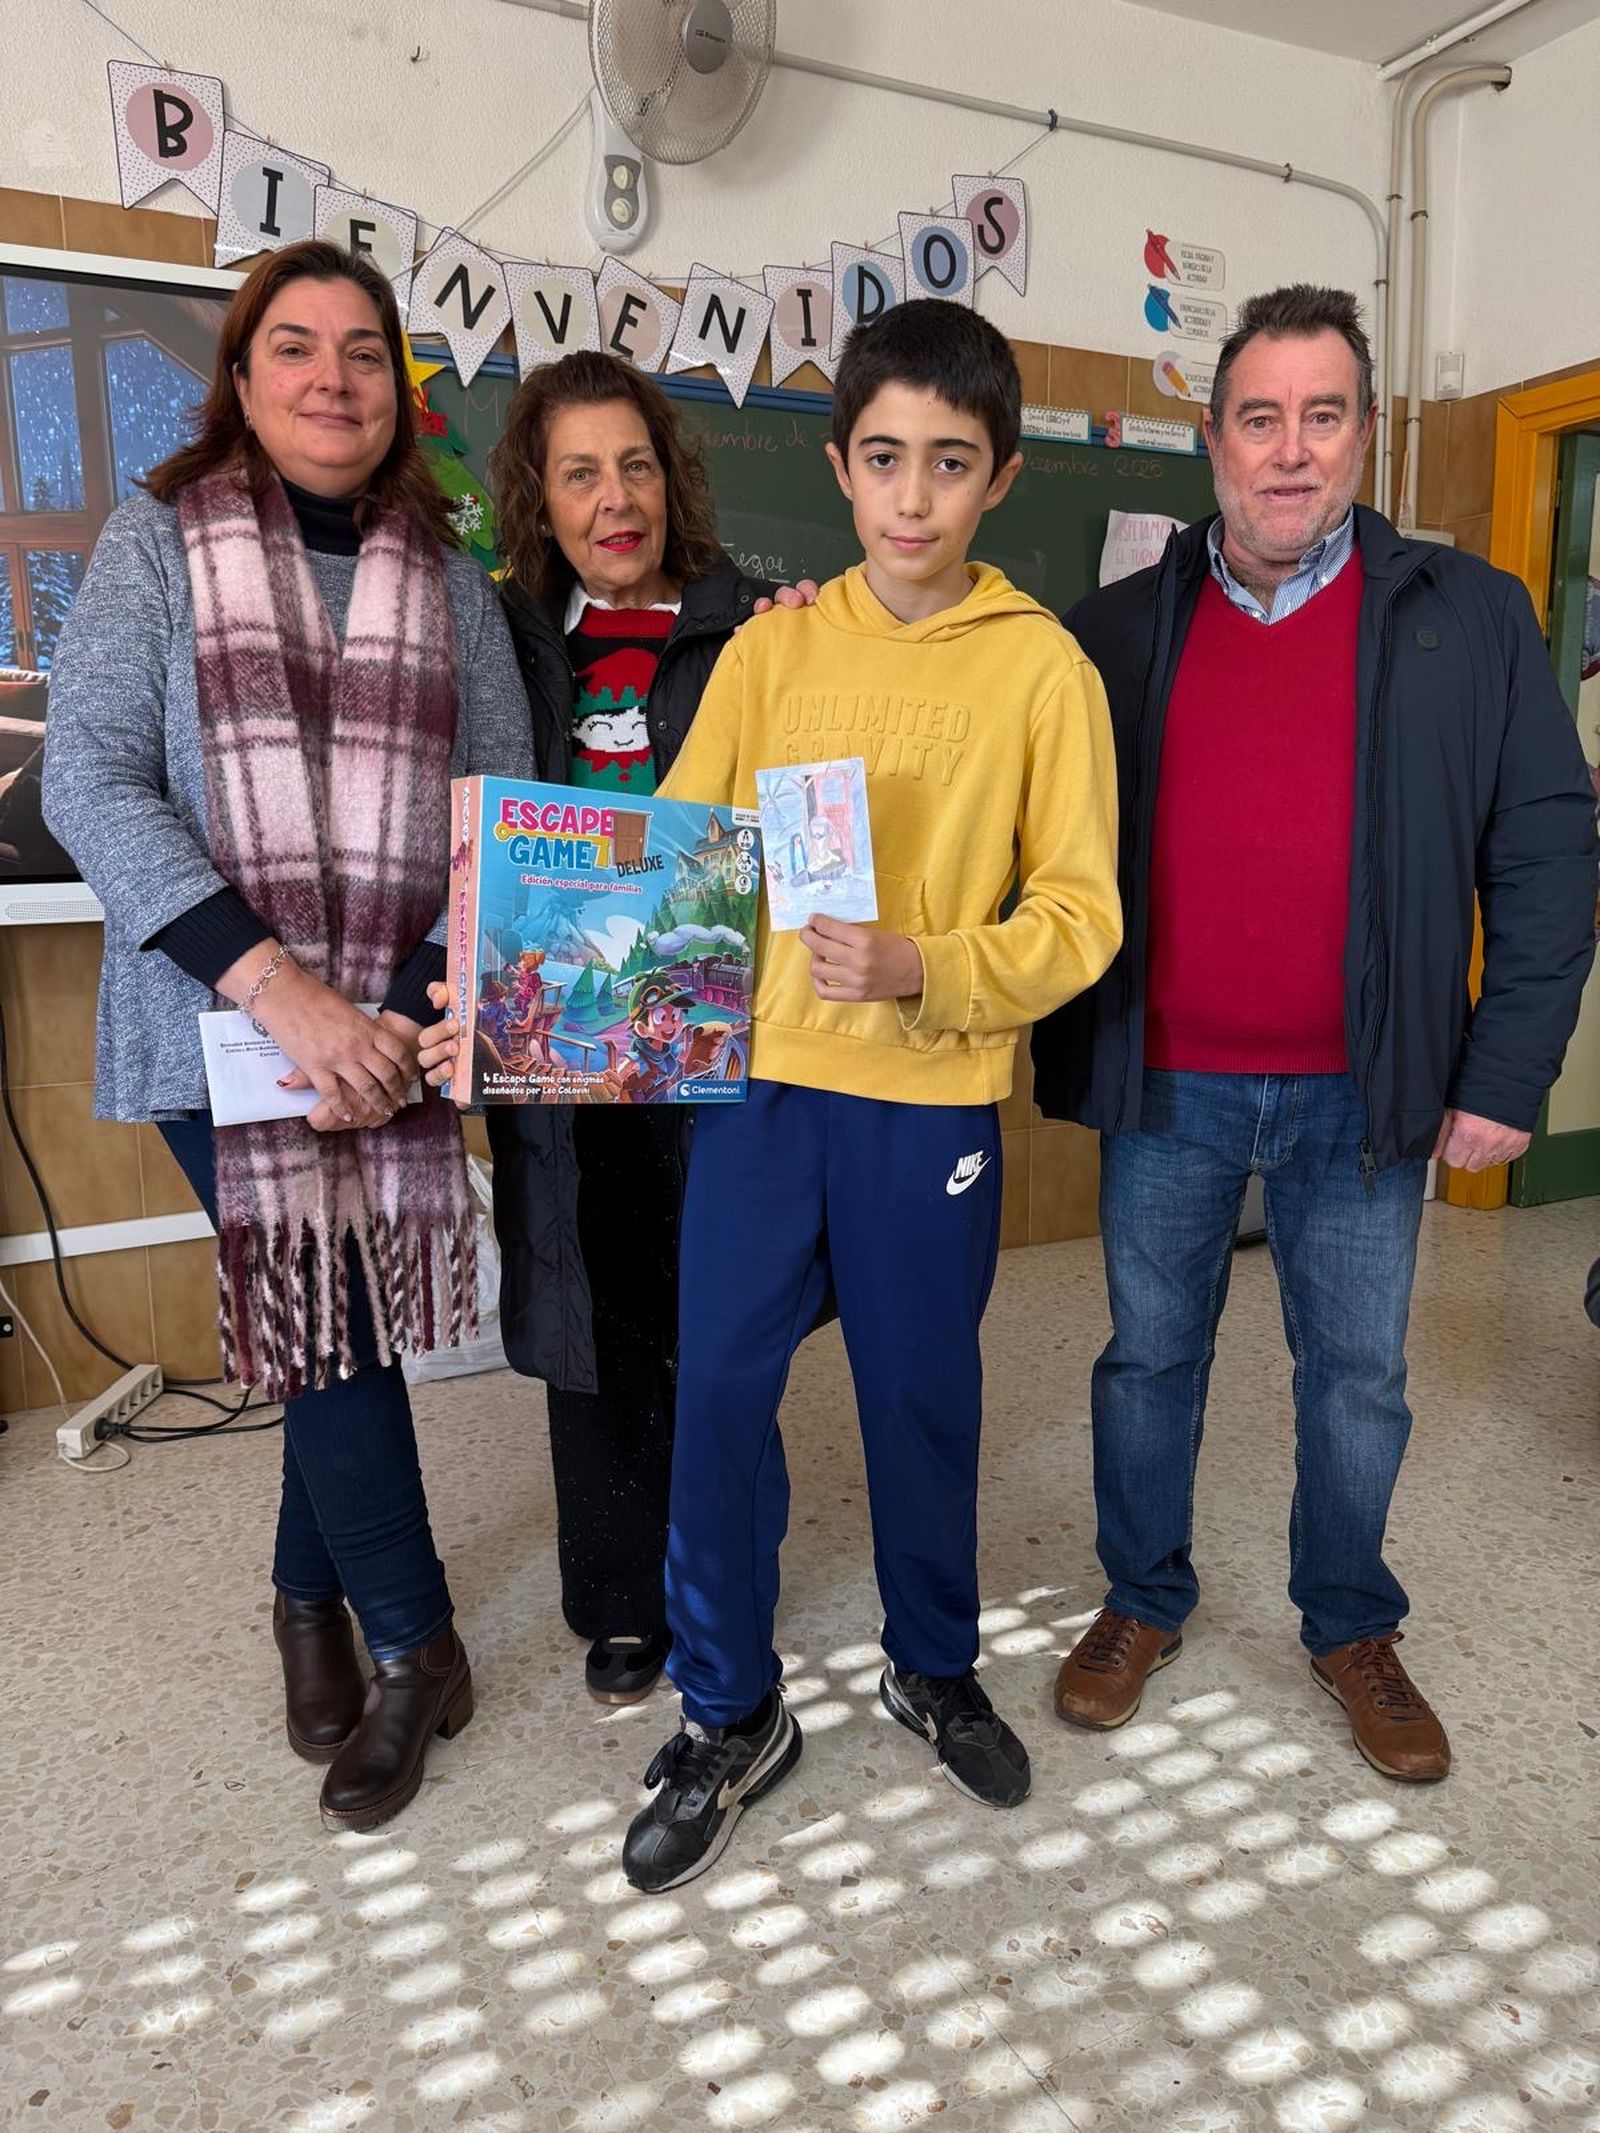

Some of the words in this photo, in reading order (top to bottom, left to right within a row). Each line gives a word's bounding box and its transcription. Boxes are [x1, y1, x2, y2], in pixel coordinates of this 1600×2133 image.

[783, 695, 971, 743] UNLIMITED
[500, 798, 616, 838] ESCAPE
[508, 835, 592, 870] GAME
[616, 854, 665, 878] DELUXE
[521, 874, 553, 886] Edición
[555, 878, 588, 890] especial
[588, 881, 608, 891] para
[609, 883, 642, 893] familias
[482, 1086, 524, 1095] diseñados
[525, 1086, 540, 1095] por
[542, 1086, 556, 1094] Leo
[492, 1073, 526, 1085] Escape
[528, 1073, 555, 1084] Game
[556, 1076, 571, 1084] con
[572, 1076, 604, 1086] enigmas
[691, 1085, 740, 1095] Clementoni
[954, 1150, 984, 1179] NIKE
